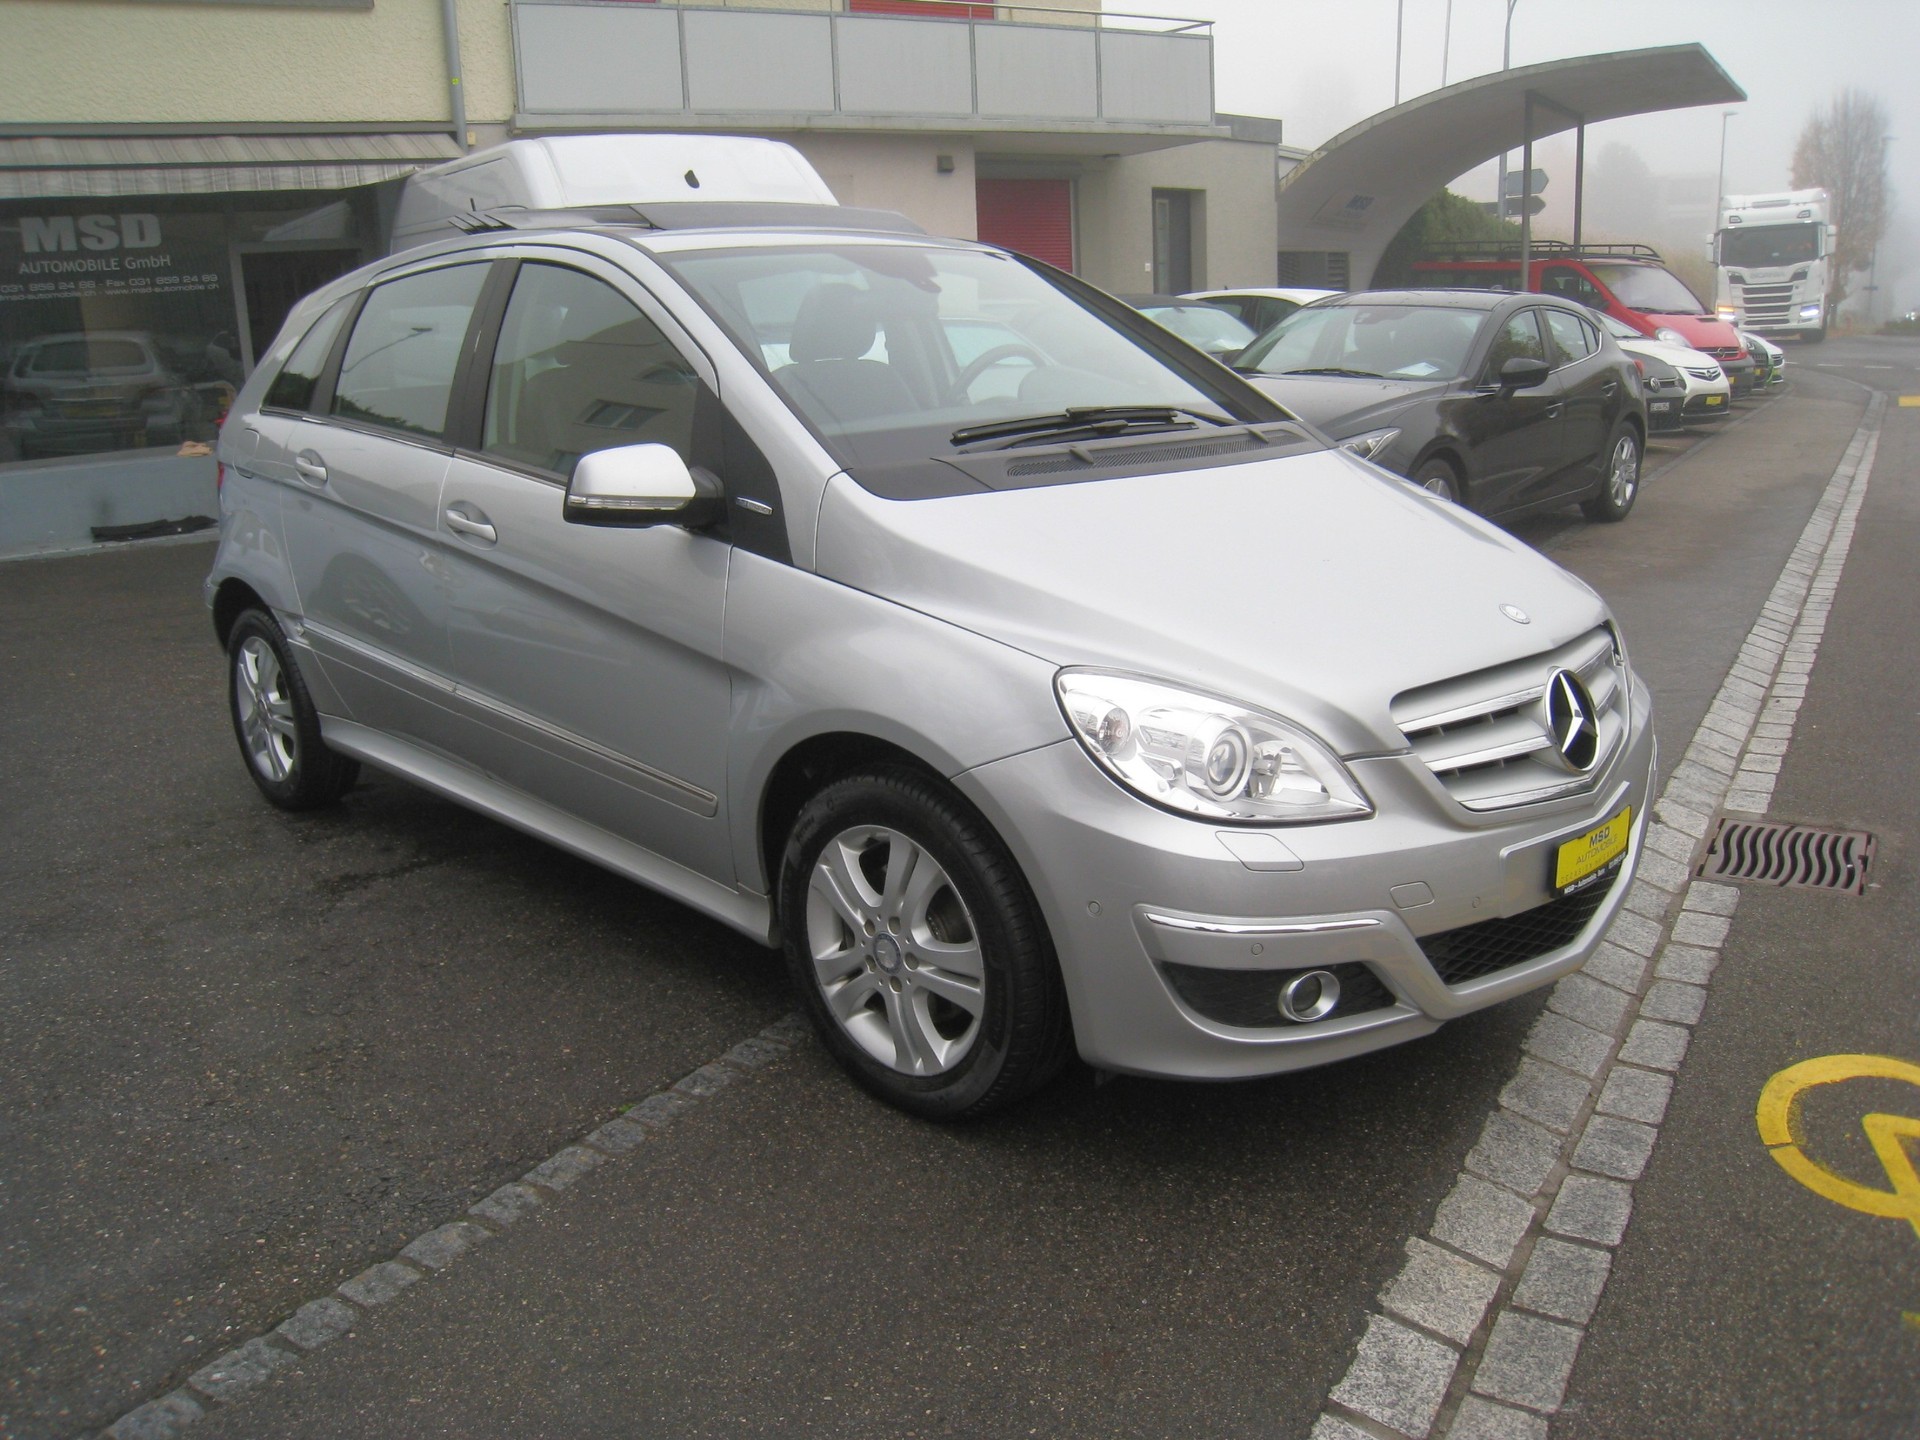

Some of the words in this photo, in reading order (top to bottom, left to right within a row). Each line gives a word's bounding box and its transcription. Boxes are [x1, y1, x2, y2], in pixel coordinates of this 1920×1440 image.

[19, 213, 162, 253] MSD
[19, 257, 120, 275] AUTOMOBILE
[124, 254, 171, 270] GmbH
[106, 279, 126, 287] Fax
[129, 277, 151, 287] 031
[156, 276, 180, 285] 859
[182, 275, 199, 283] 24
[201, 274, 218, 283] 89
[1589, 826, 1610, 848] MSD
[1576, 834, 1618, 865] AUTOMOBILE
